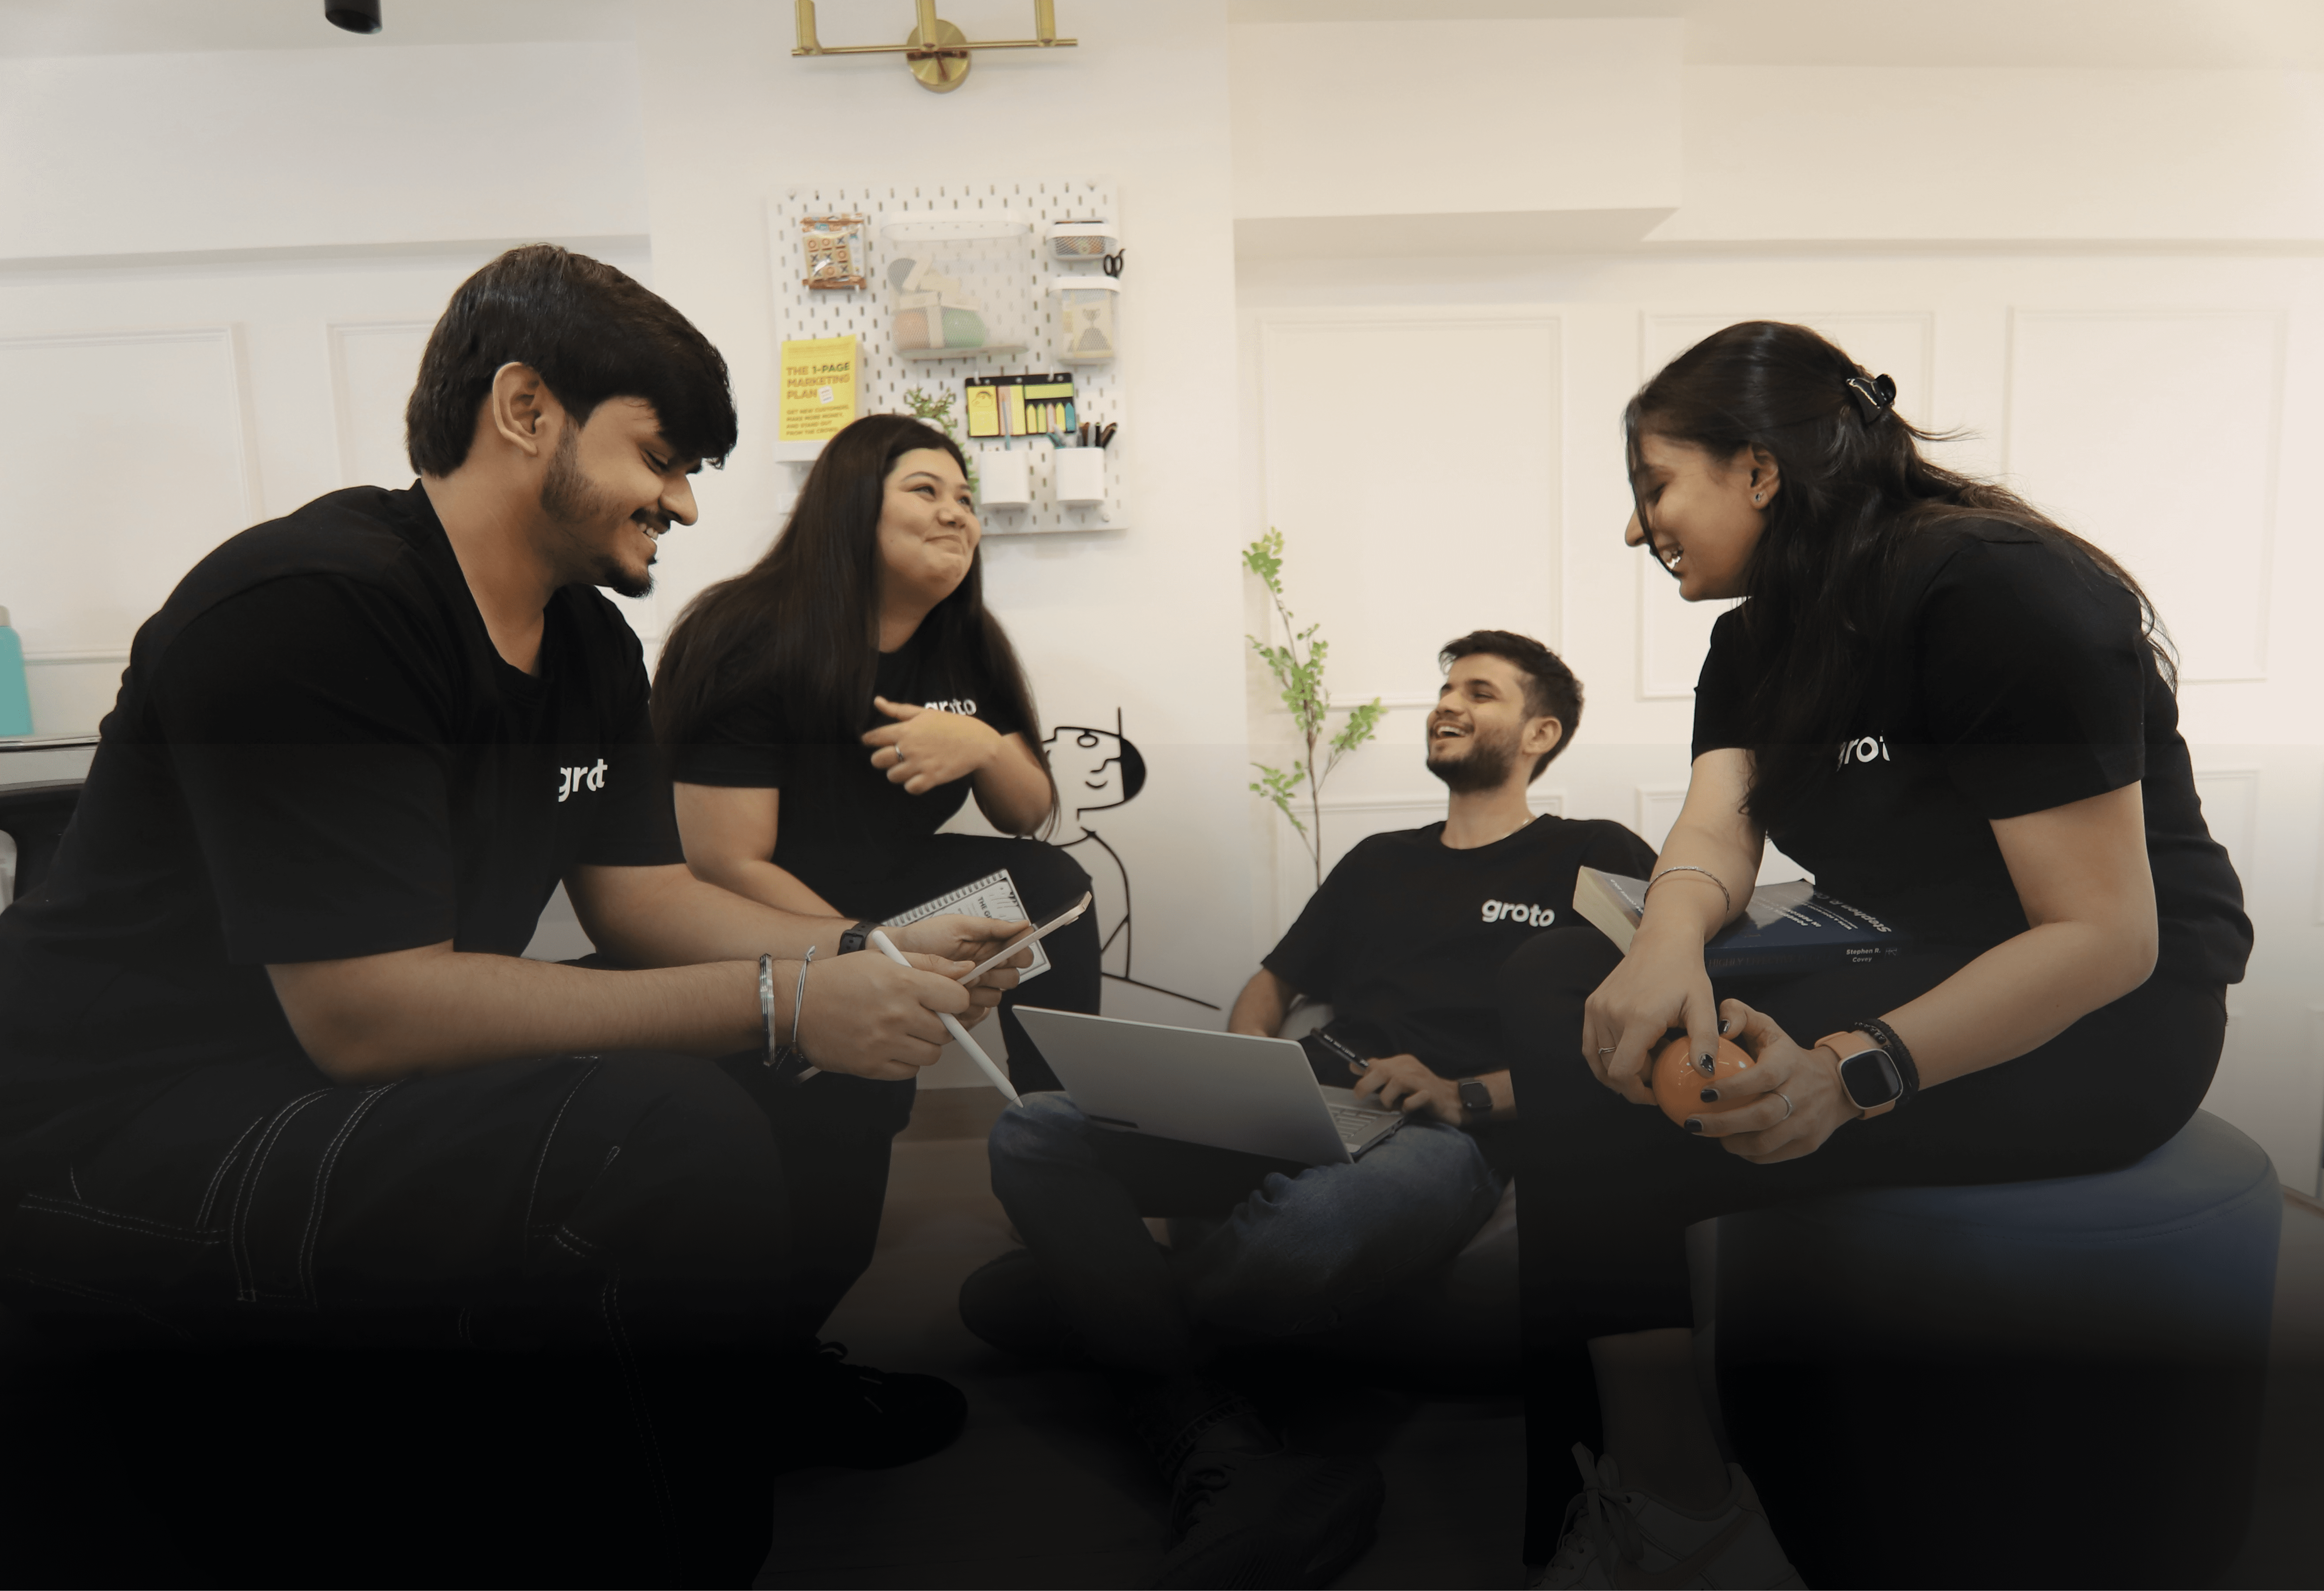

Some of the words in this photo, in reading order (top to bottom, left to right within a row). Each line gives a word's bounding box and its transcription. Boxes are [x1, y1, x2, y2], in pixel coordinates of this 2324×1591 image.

[787, 366, 808, 375] THE
[813, 362, 850, 374] 1-PAGE
[787, 374, 850, 387] MARKETING
[787, 389, 817, 399] PLAN
[978, 896, 988, 910] THE
[1482, 899, 1555, 927] groto
